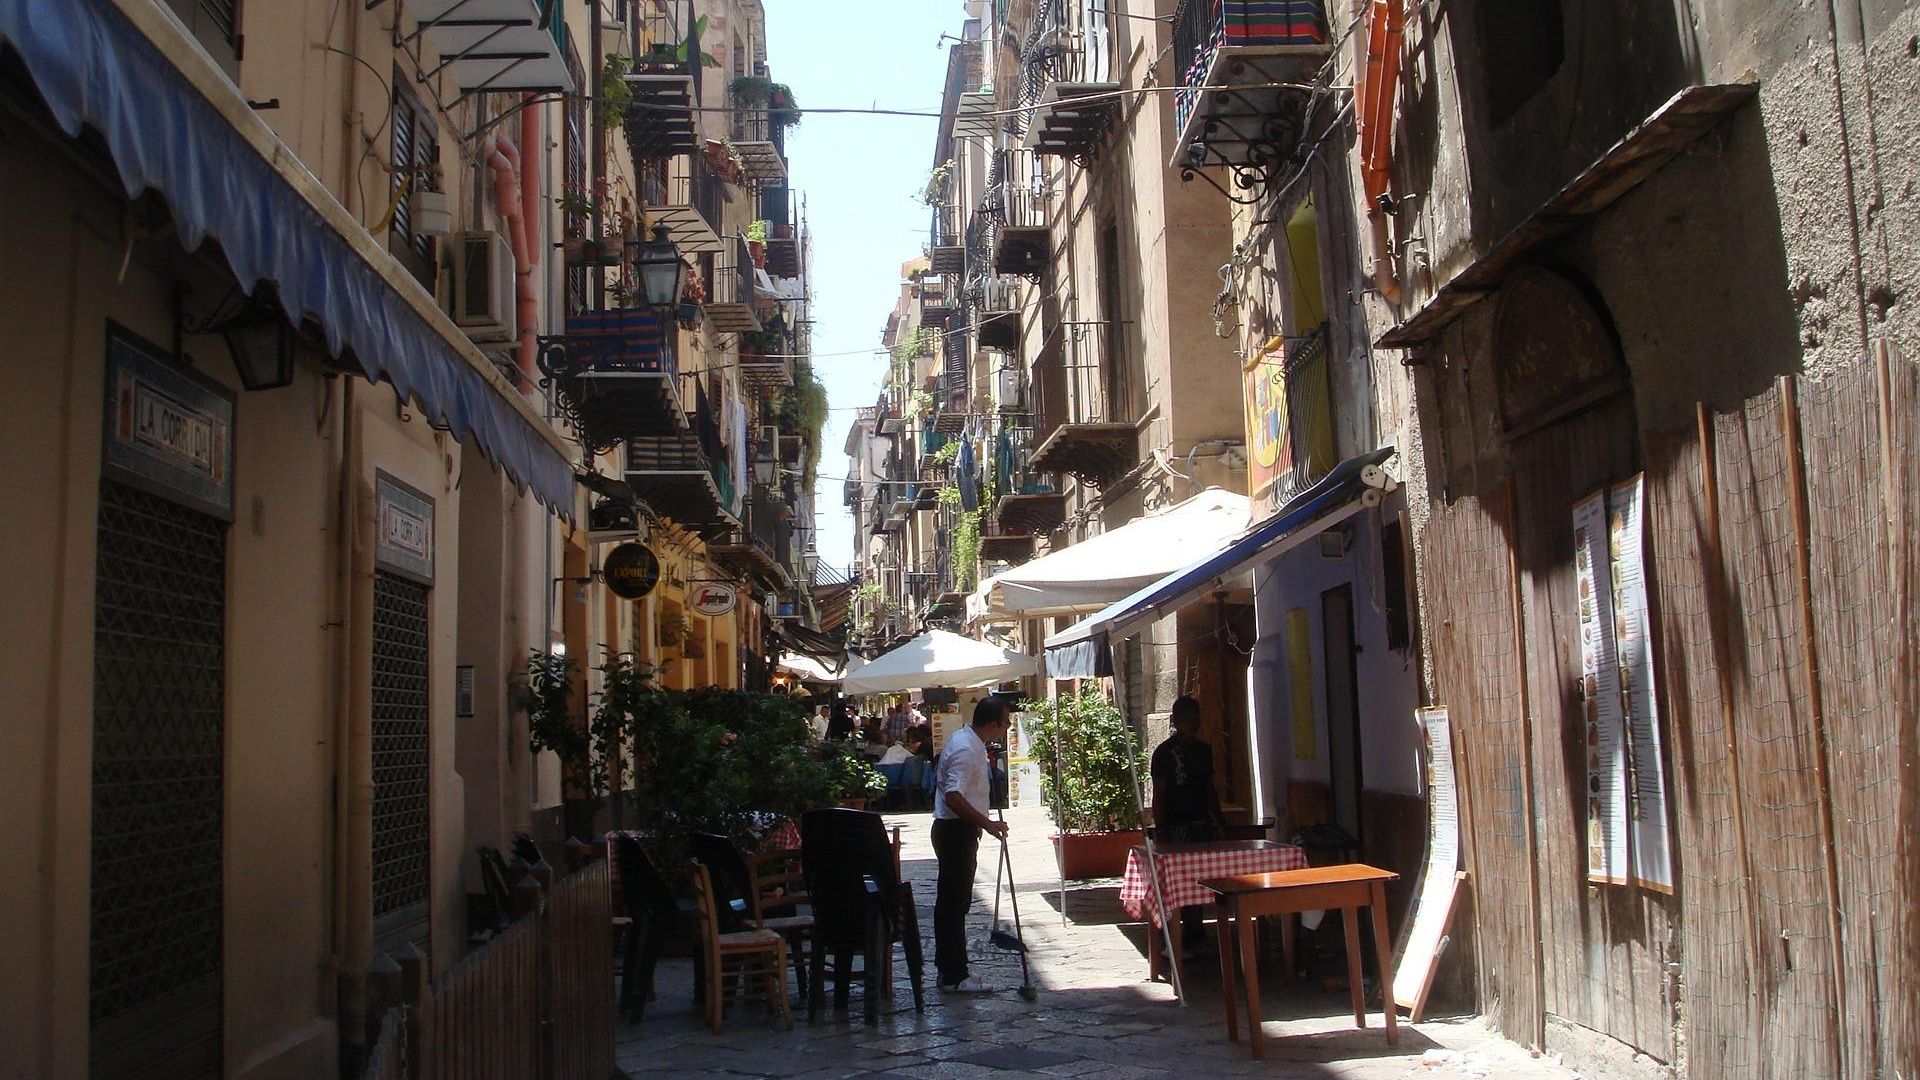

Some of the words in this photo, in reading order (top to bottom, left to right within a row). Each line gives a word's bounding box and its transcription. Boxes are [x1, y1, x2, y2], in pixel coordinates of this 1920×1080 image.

[138, 393, 155, 435] LA
[162, 408, 209, 462] CORRIDA
[390, 511, 399, 535] LA
[401, 517, 422, 547] CORRIDA
